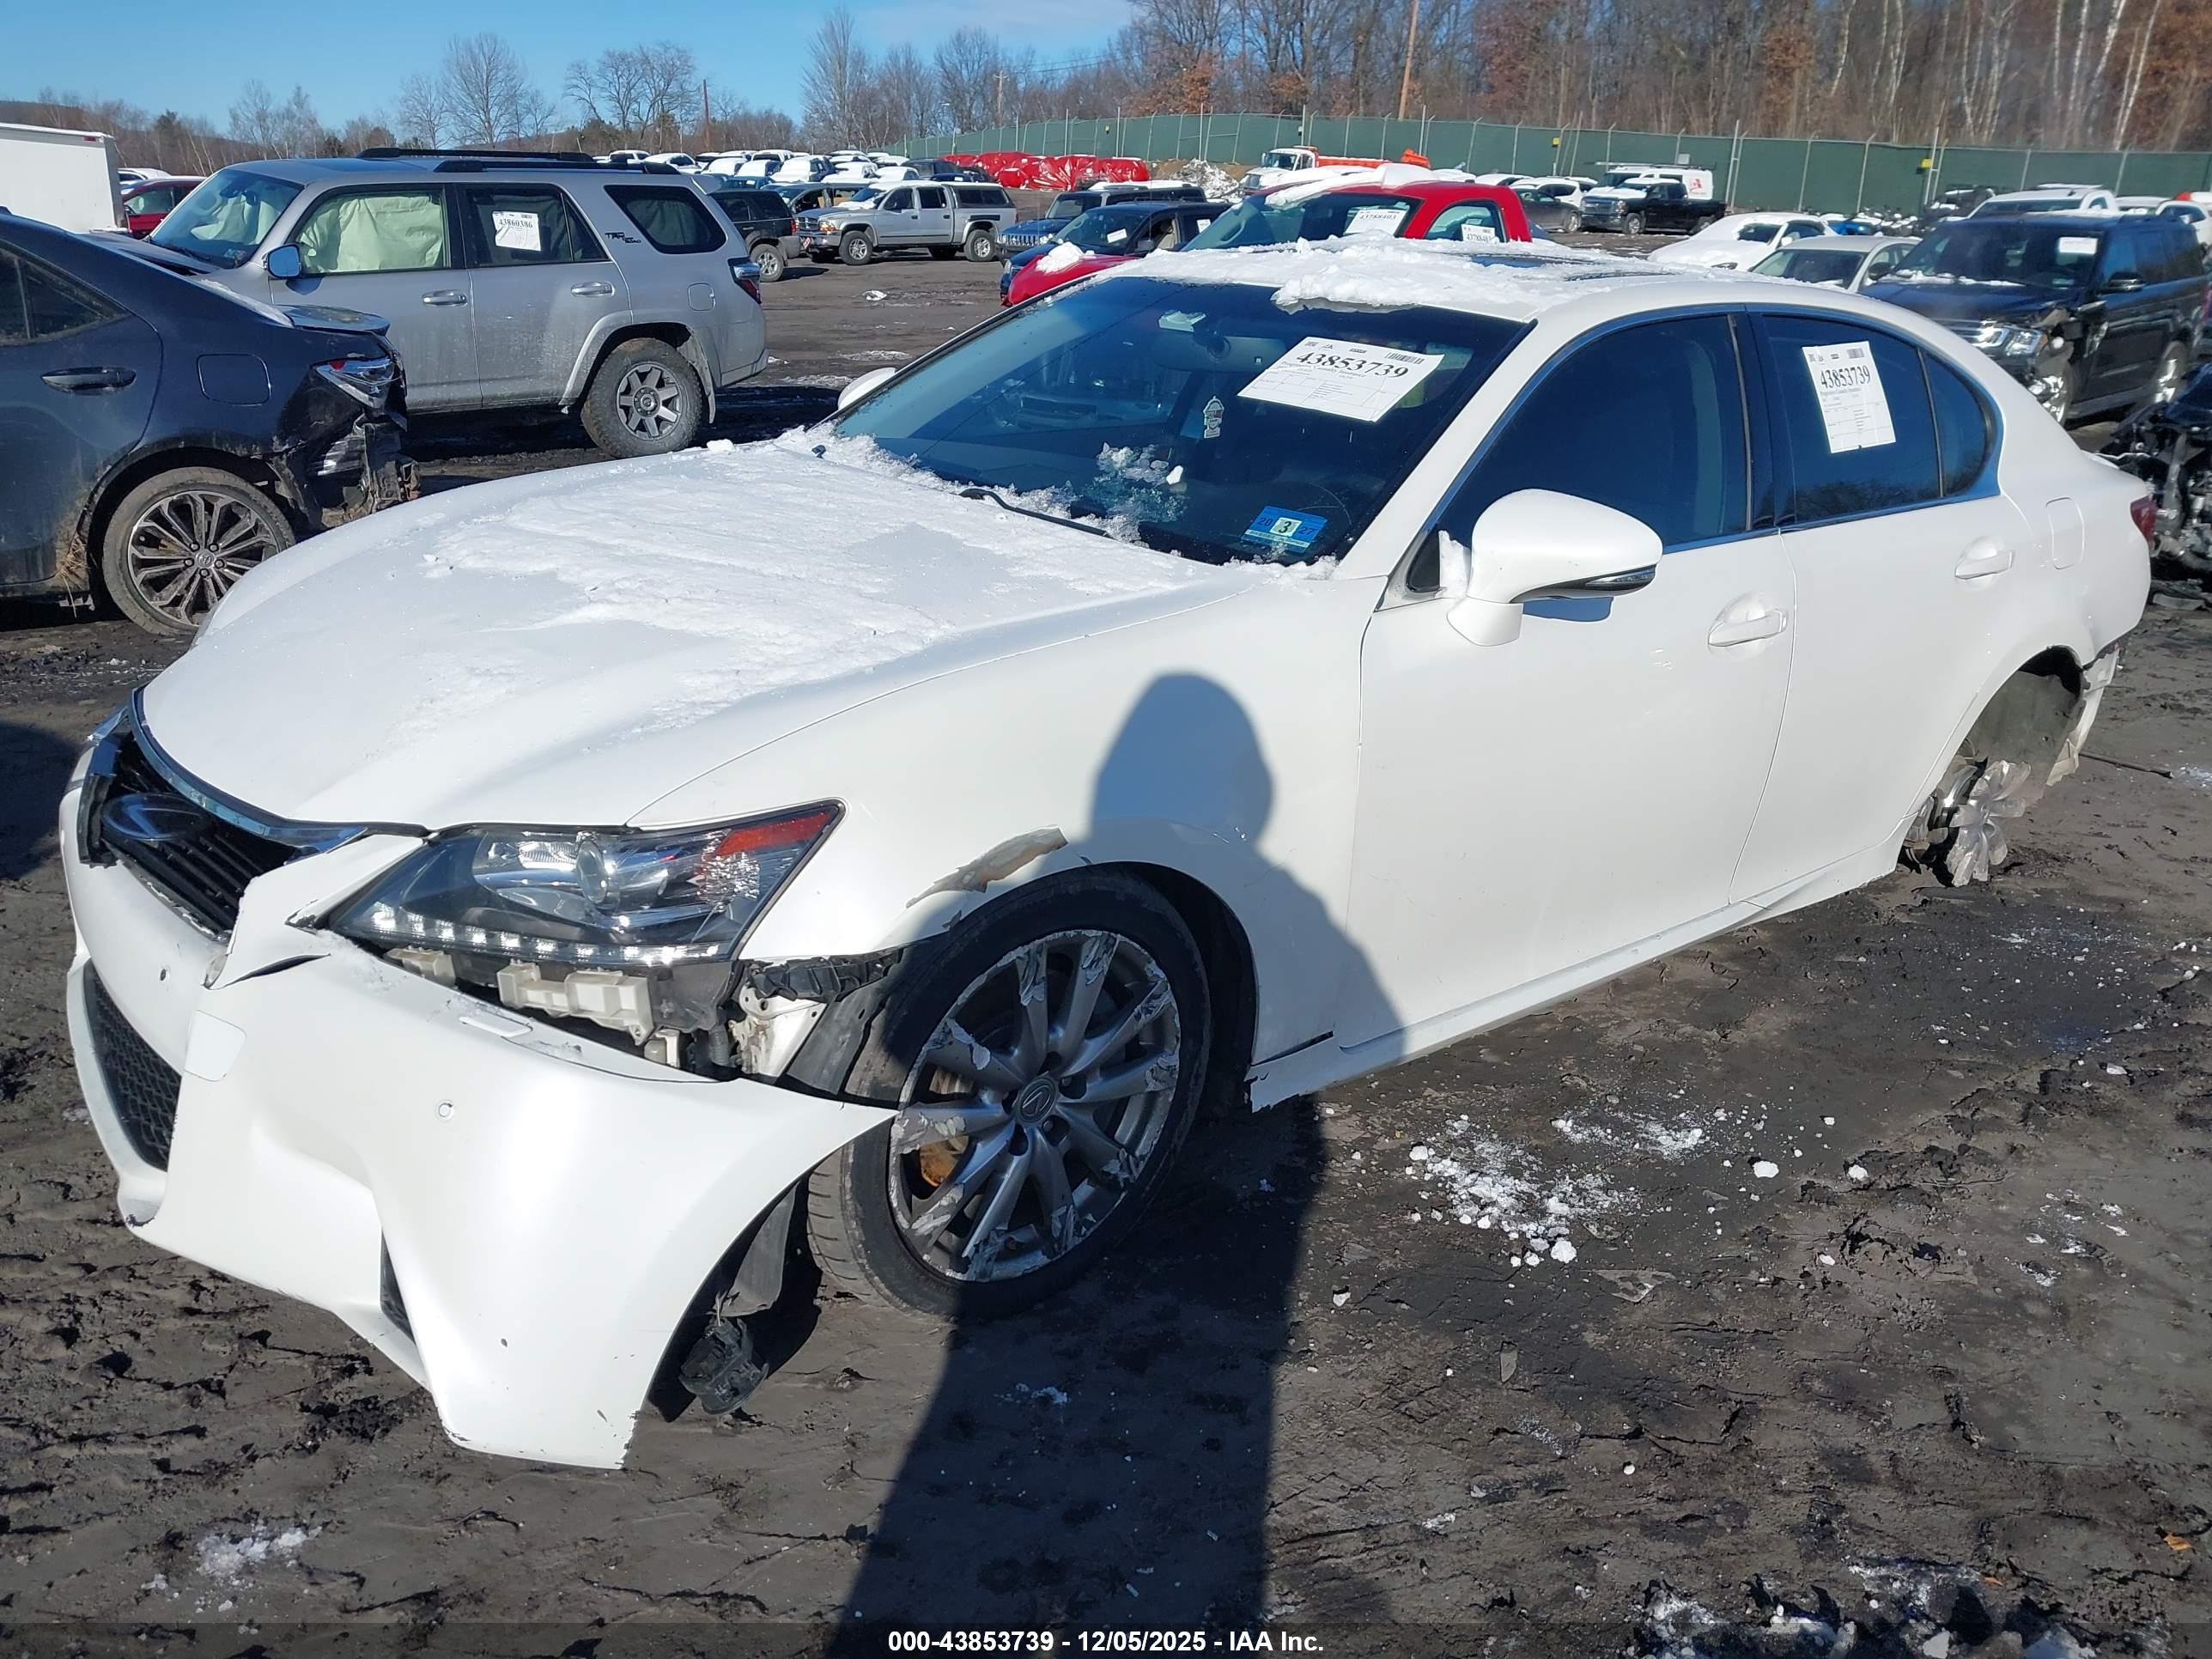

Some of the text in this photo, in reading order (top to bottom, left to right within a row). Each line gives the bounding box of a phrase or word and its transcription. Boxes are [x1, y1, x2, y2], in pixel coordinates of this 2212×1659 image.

[1297, 352, 1409, 378] 43853739
[1820, 365, 1870, 389] 43853739
[1257, 517, 1316, 536] 20 3 27
